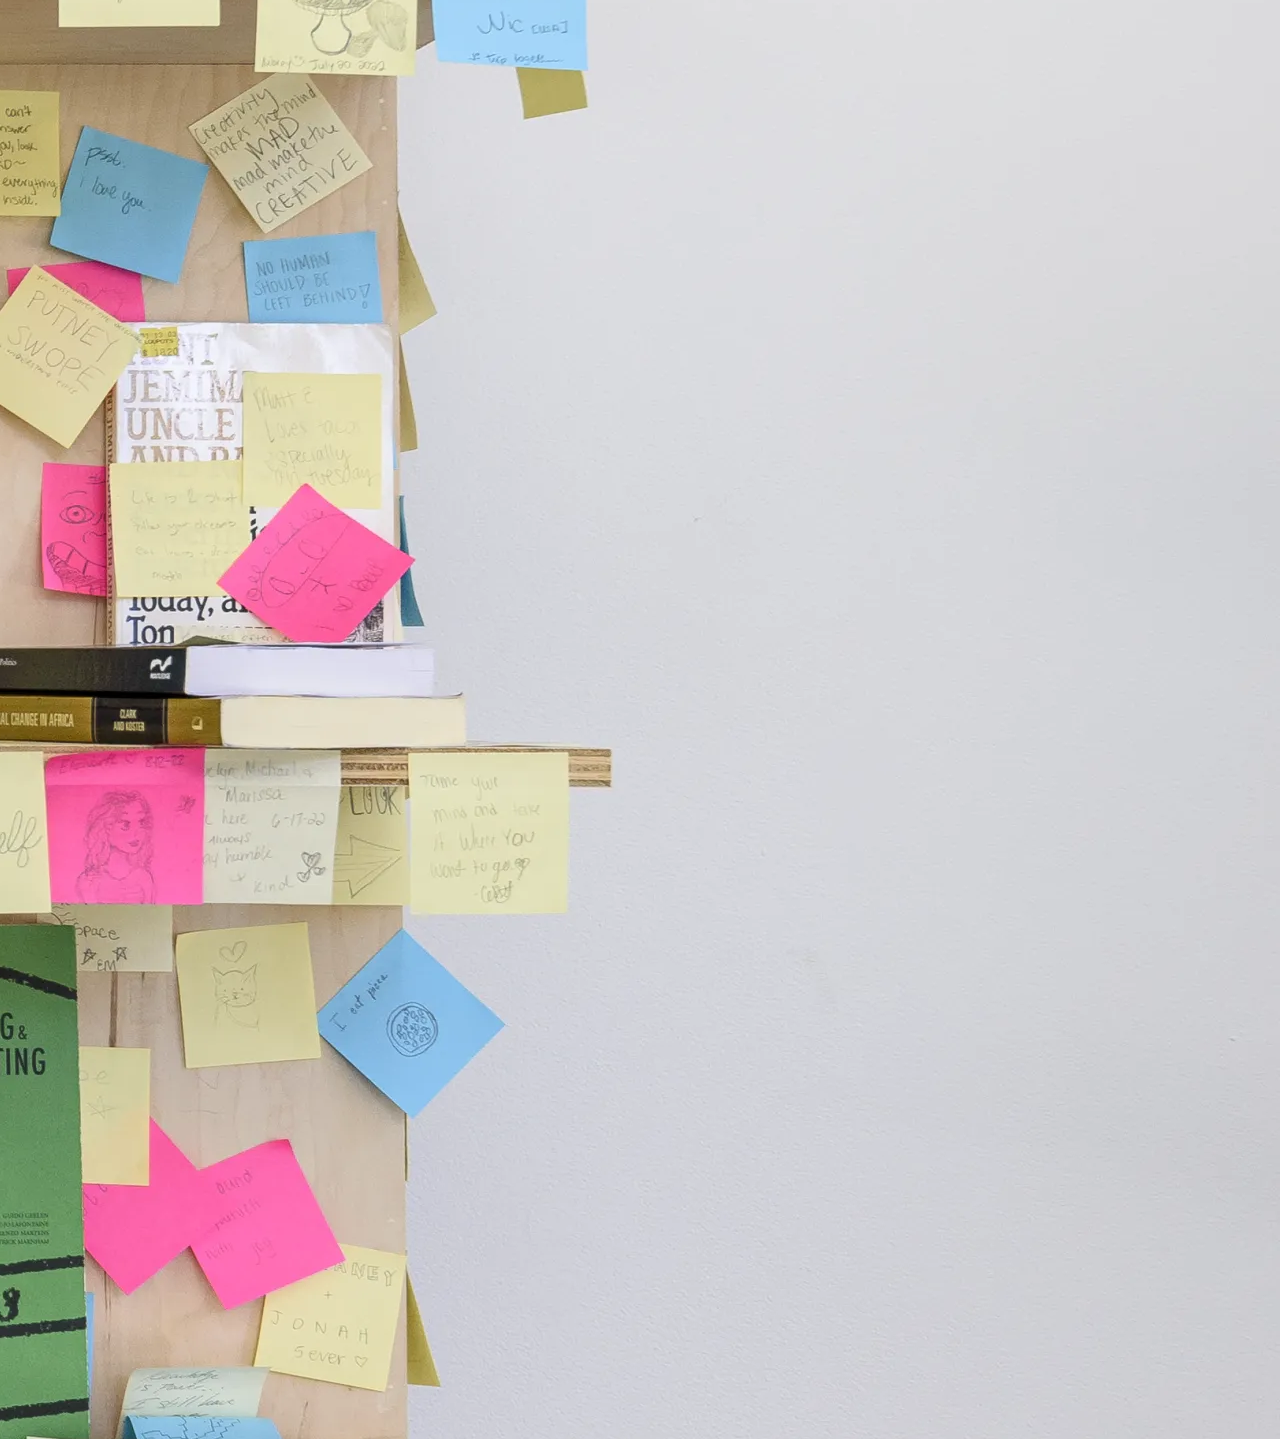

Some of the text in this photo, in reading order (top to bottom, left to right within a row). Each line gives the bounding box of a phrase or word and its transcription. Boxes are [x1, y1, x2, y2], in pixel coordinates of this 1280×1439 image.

[256, 261, 274, 277] NO
[253, 272, 329, 296] SHOULD BE
[264, 283, 371, 311] LEFT BEHIND!
[11, 713, 38, 726] CHANGE
[40, 713, 47, 727] IN
[48, 713, 74, 727] AFRICA
[120, 709, 136, 719] CLARK
[113, 721, 144, 731] AND KOSTER
[18, 1025, 28, 1039] &
